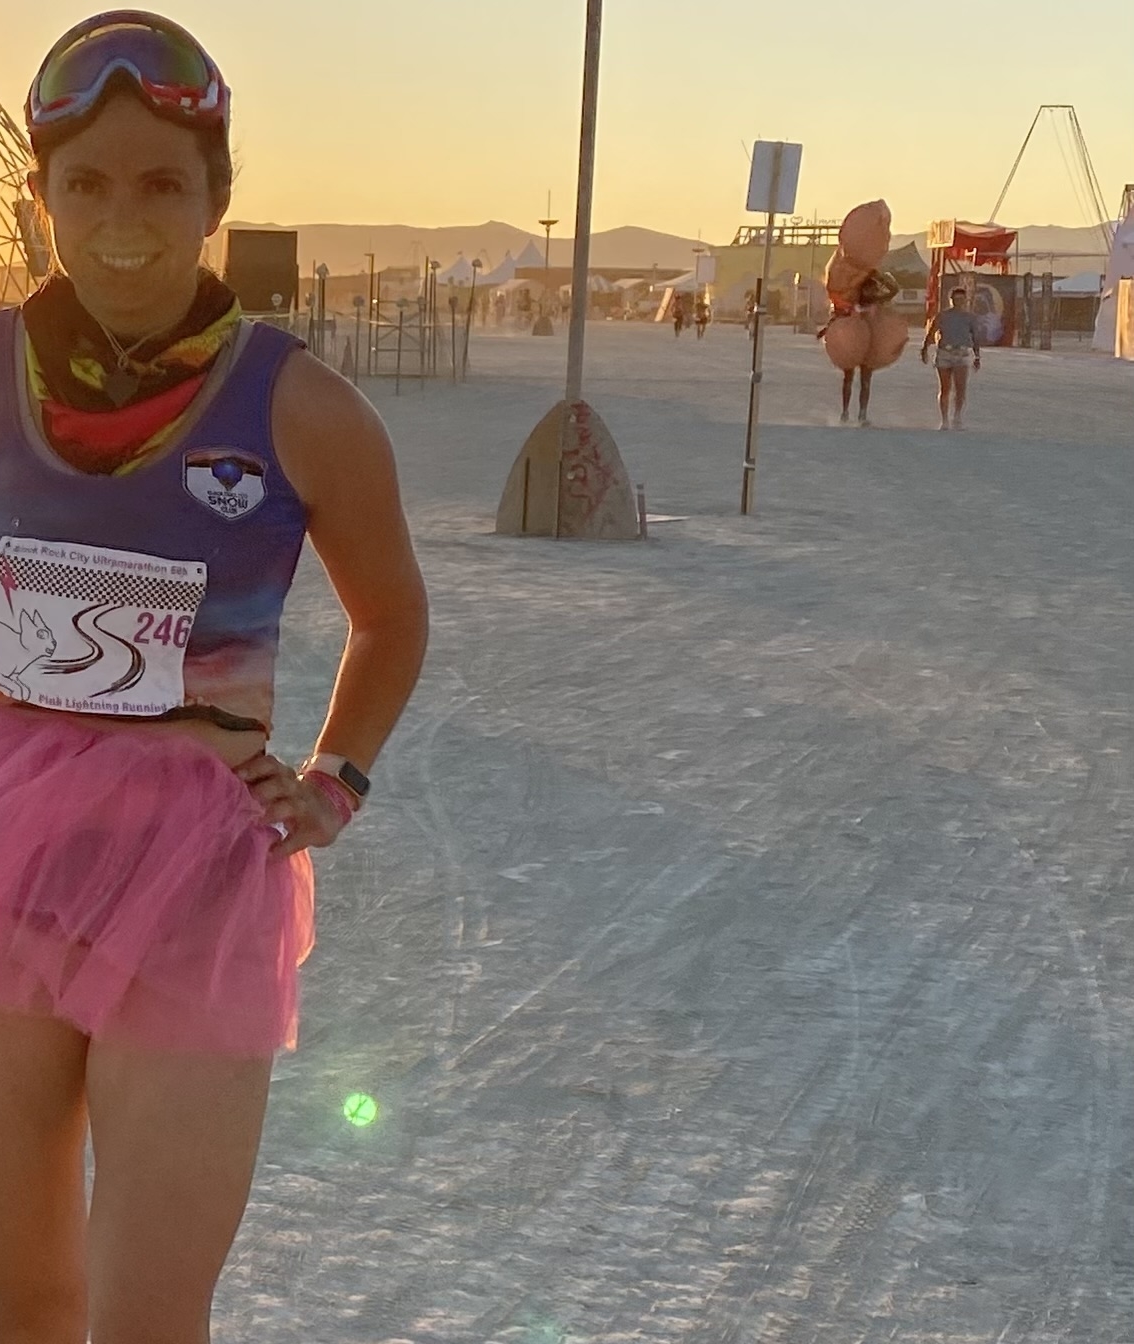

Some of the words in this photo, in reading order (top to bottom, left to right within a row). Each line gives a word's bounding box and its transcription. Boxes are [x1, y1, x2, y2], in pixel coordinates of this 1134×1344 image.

[208, 496, 248, 509] SNOW
[41, 546, 66, 558] Rock
[69, 551, 90, 564] City
[92, 555, 167, 573] Ultramarathon
[133, 611, 193, 649] 246
[38, 694, 62, 706] Pink
[65, 697, 120, 713] Lightning
